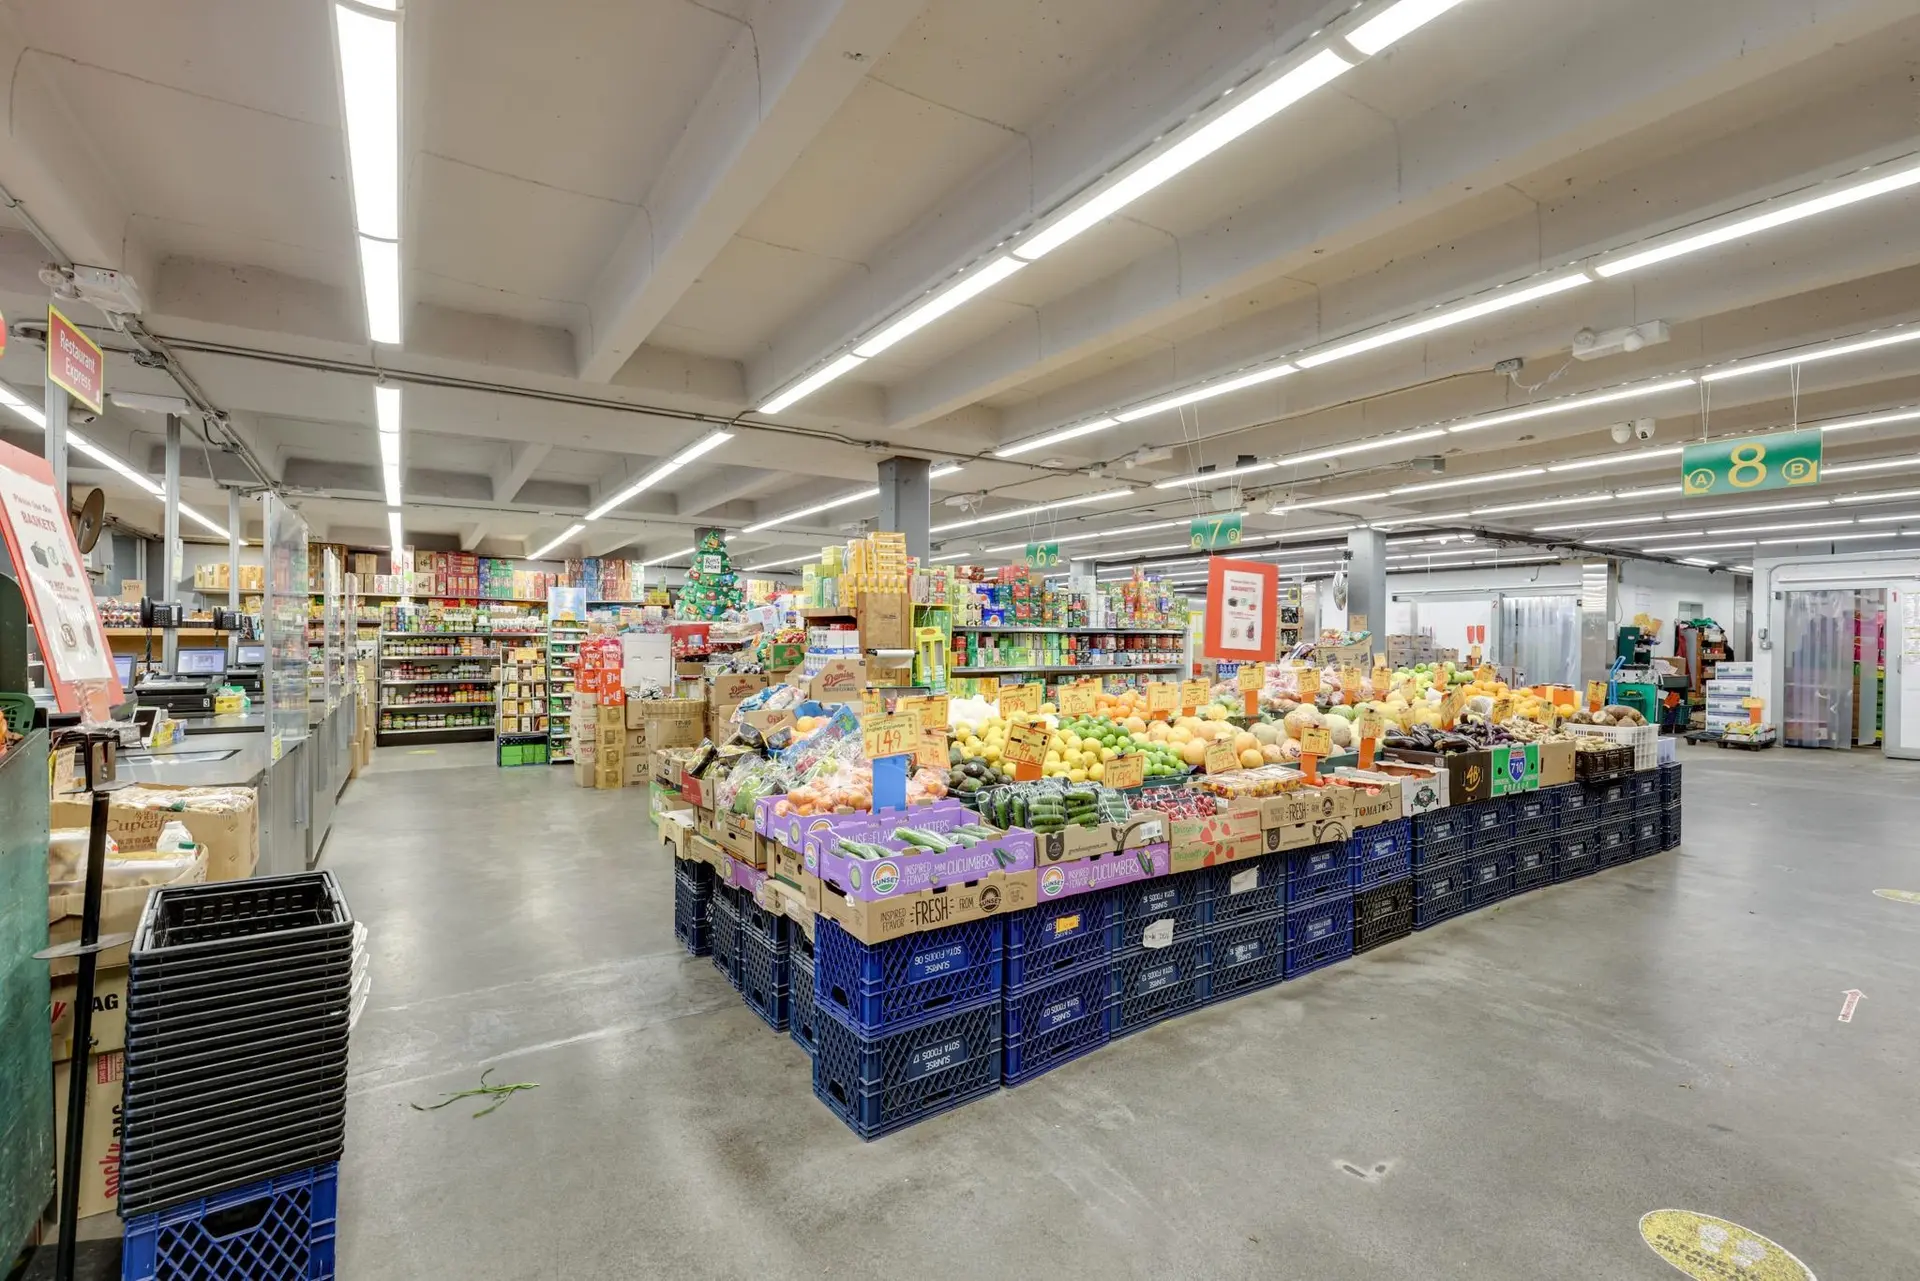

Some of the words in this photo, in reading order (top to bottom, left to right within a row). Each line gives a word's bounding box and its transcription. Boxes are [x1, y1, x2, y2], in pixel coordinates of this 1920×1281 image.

[60, 330, 95, 373] Restaurant
[65, 357, 91, 391] Express
[1695, 473, 1707, 486] A
[1728, 443, 1767, 488] 8
[1791, 463, 1805, 477] B
[20, 511, 57, 533] BASKETS
[1209, 518, 1224, 546] 7
[1037, 544, 1046, 566] 6
[1492, 600, 1498, 609] 2
[1892, 592, 1898, 602] 1
[876, 729, 902, 753] 1.49
[1510, 761, 1524, 774] 710
[1288, 803, 1306, 821] FRESH
[946, 852, 996, 873] CUCUMBERS
[1091, 858, 1139, 881] CUCUMBERS
[872, 876, 899, 888] SUNSET
[1043, 879, 1064, 889] SUNSET
[1149, 893, 1163, 902] FOODS
[915, 897, 948, 925] FRESH
[959, 897, 974, 911] FROM
[979, 897, 1002, 908] SUNSET
[1150, 900, 1168, 911] SUNRISE
[880, 908, 906, 922] INSPIRED
[924, 950, 945, 963] FOODS
[924, 960, 950, 975] SUNRISE
[1147, 969, 1162, 979] FOODS
[1148, 977, 1166, 989] SUNRISE
[1050, 1001, 1067, 1015] FOODS
[1051, 1010, 1071, 1025] SUNRISE
[922, 1046, 943, 1061] FOODS
[924, 1055, 951, 1072] SUNRISE
